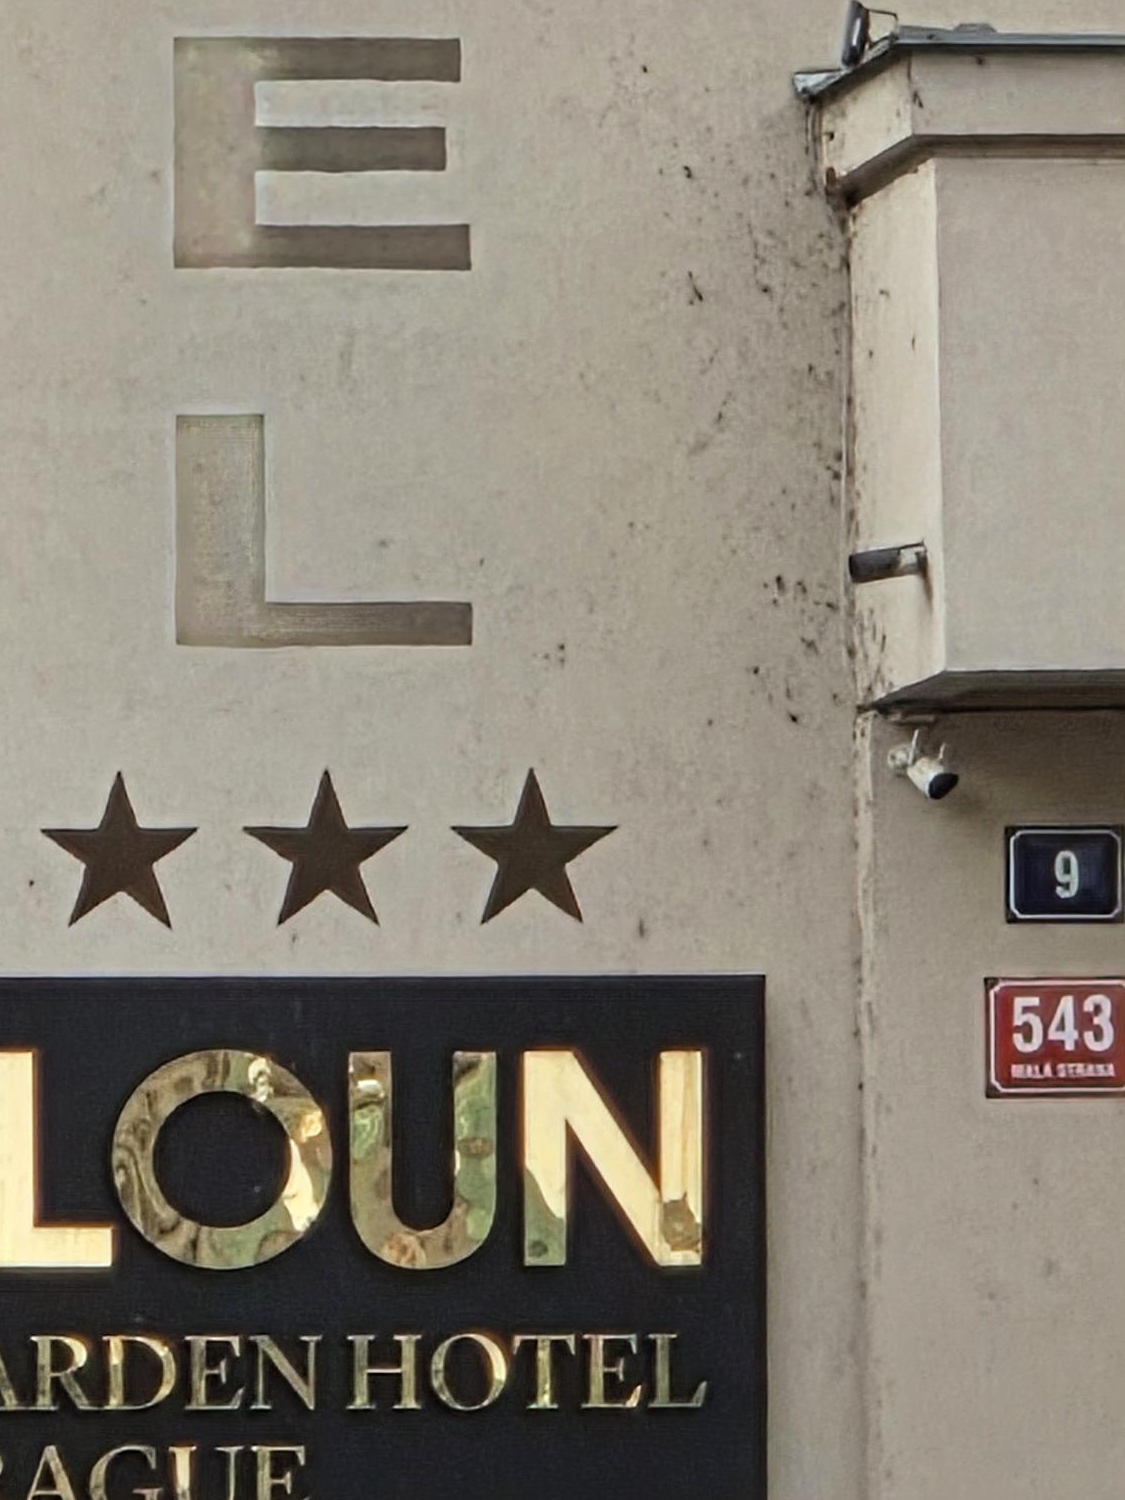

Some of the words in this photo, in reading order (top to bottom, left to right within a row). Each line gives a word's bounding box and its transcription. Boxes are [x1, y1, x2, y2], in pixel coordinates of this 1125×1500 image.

[1054, 850, 1079, 899] 9
[1012, 994, 1114, 1053] 543
[346, 1332, 708, 1411] HOTEL
